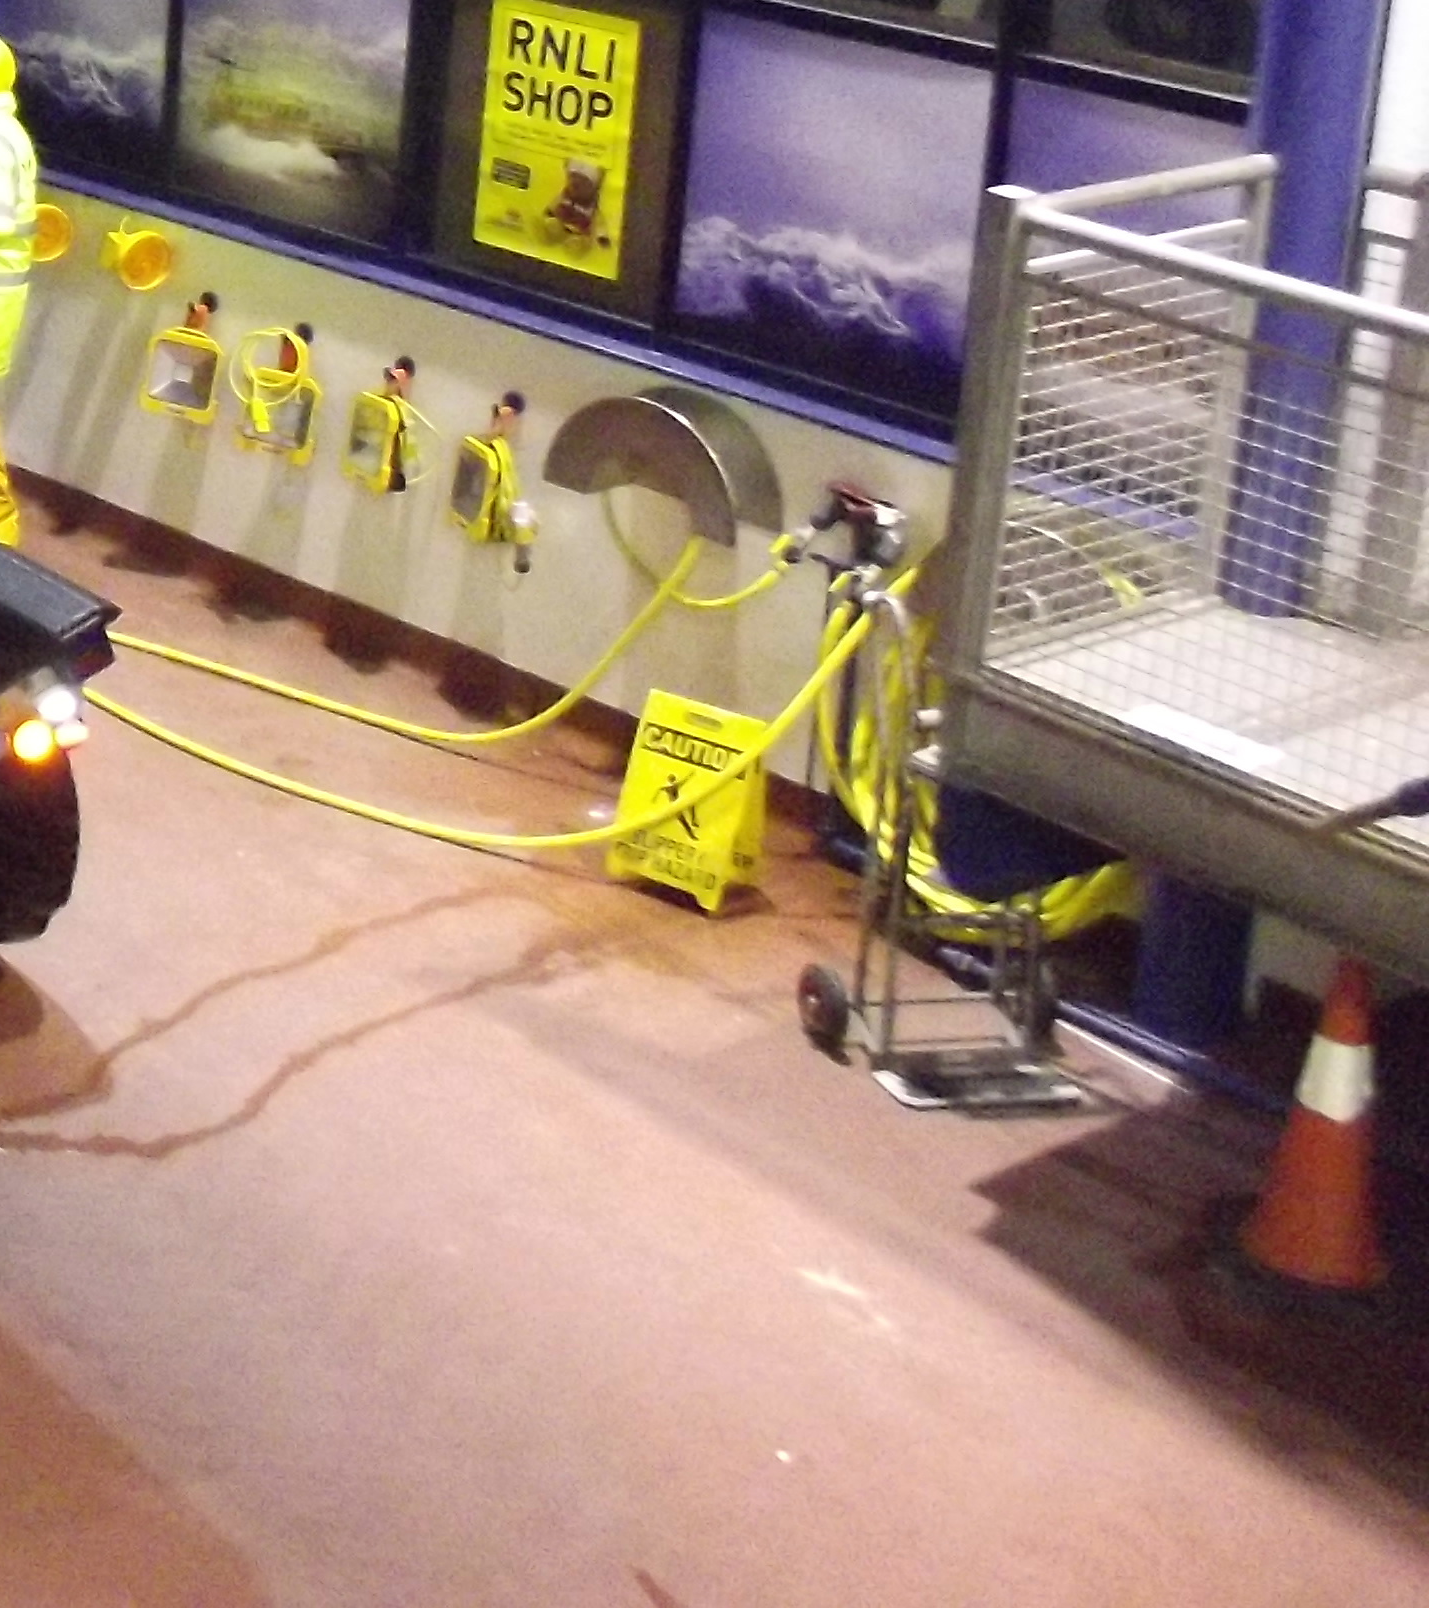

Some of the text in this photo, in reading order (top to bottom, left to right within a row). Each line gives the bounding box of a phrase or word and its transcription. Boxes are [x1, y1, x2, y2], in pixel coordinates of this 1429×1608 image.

[507, 18, 617, 84] RNLI
[502, 72, 614, 131] SHOP
[642, 725, 741, 776] CAUTIO
